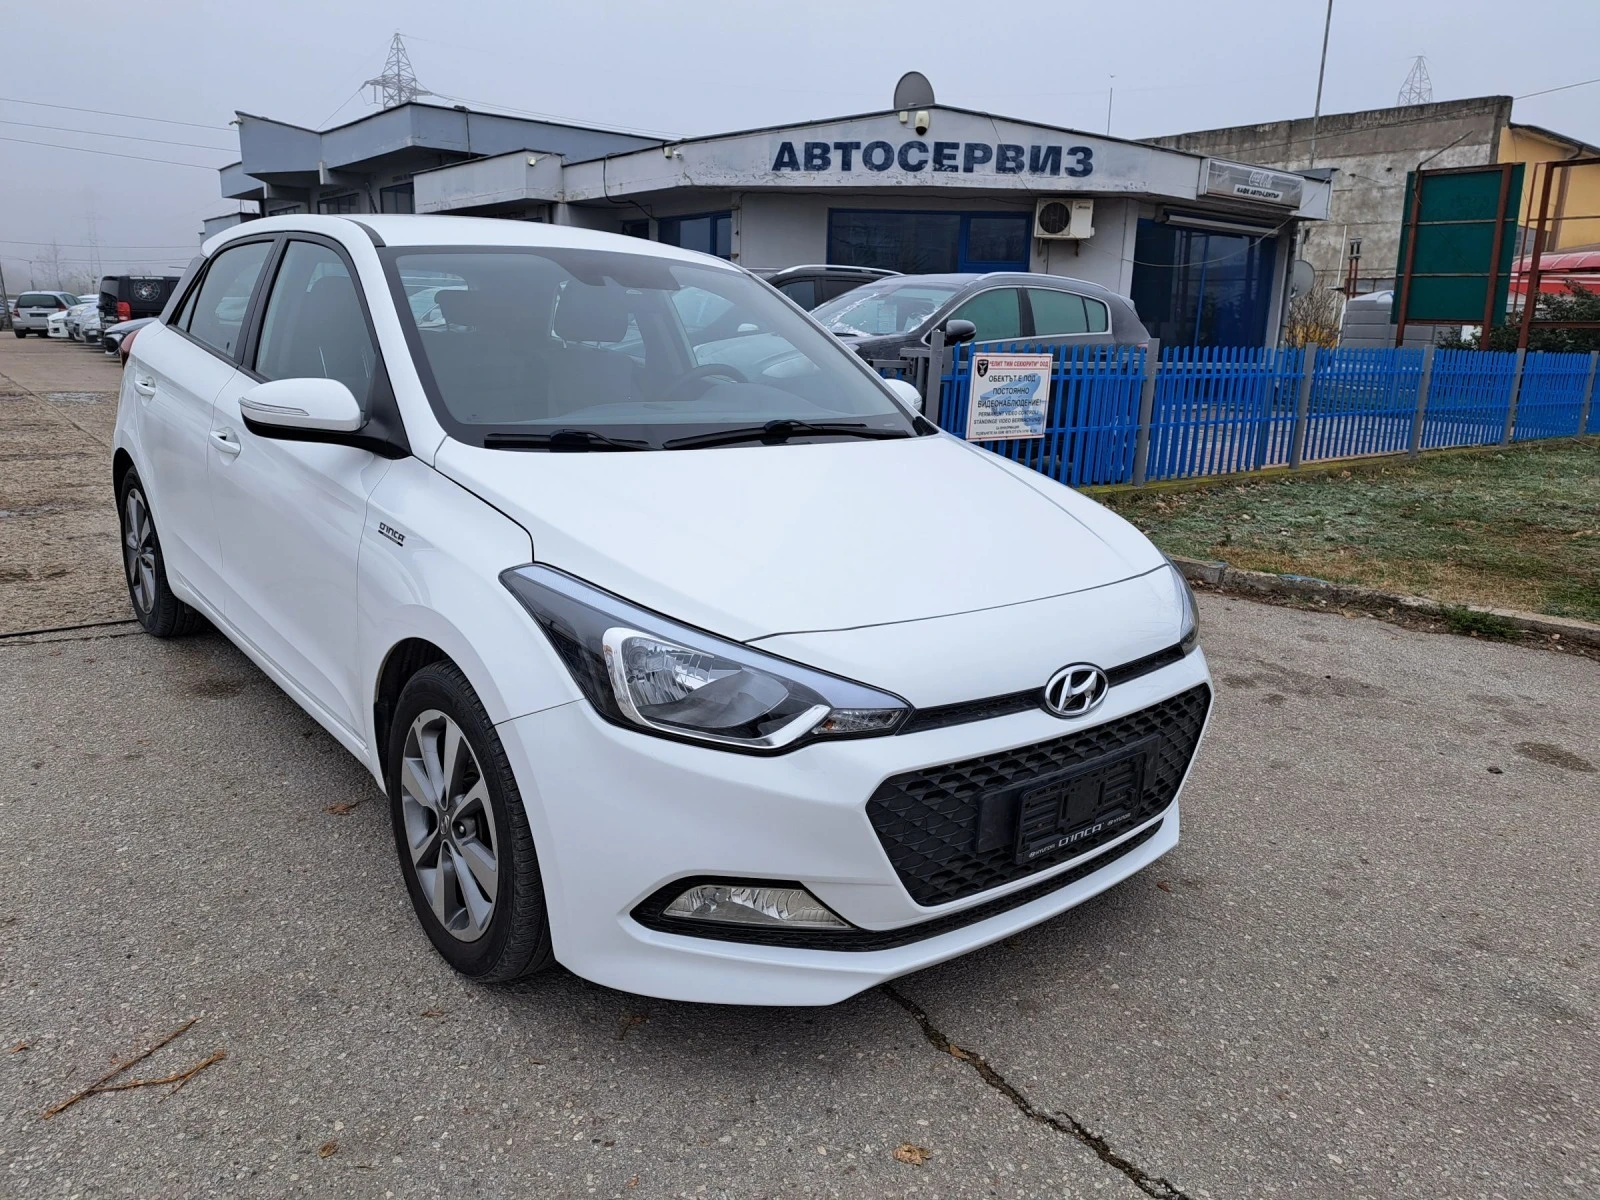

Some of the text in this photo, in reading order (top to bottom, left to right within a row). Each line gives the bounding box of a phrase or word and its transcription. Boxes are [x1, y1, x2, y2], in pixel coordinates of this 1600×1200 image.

[771, 140, 1093, 178] АВТОСЕРВИЗ
[988, 375, 1017, 383] ОБЕКТЪТ
[1023, 375, 1036, 383] ПОД
